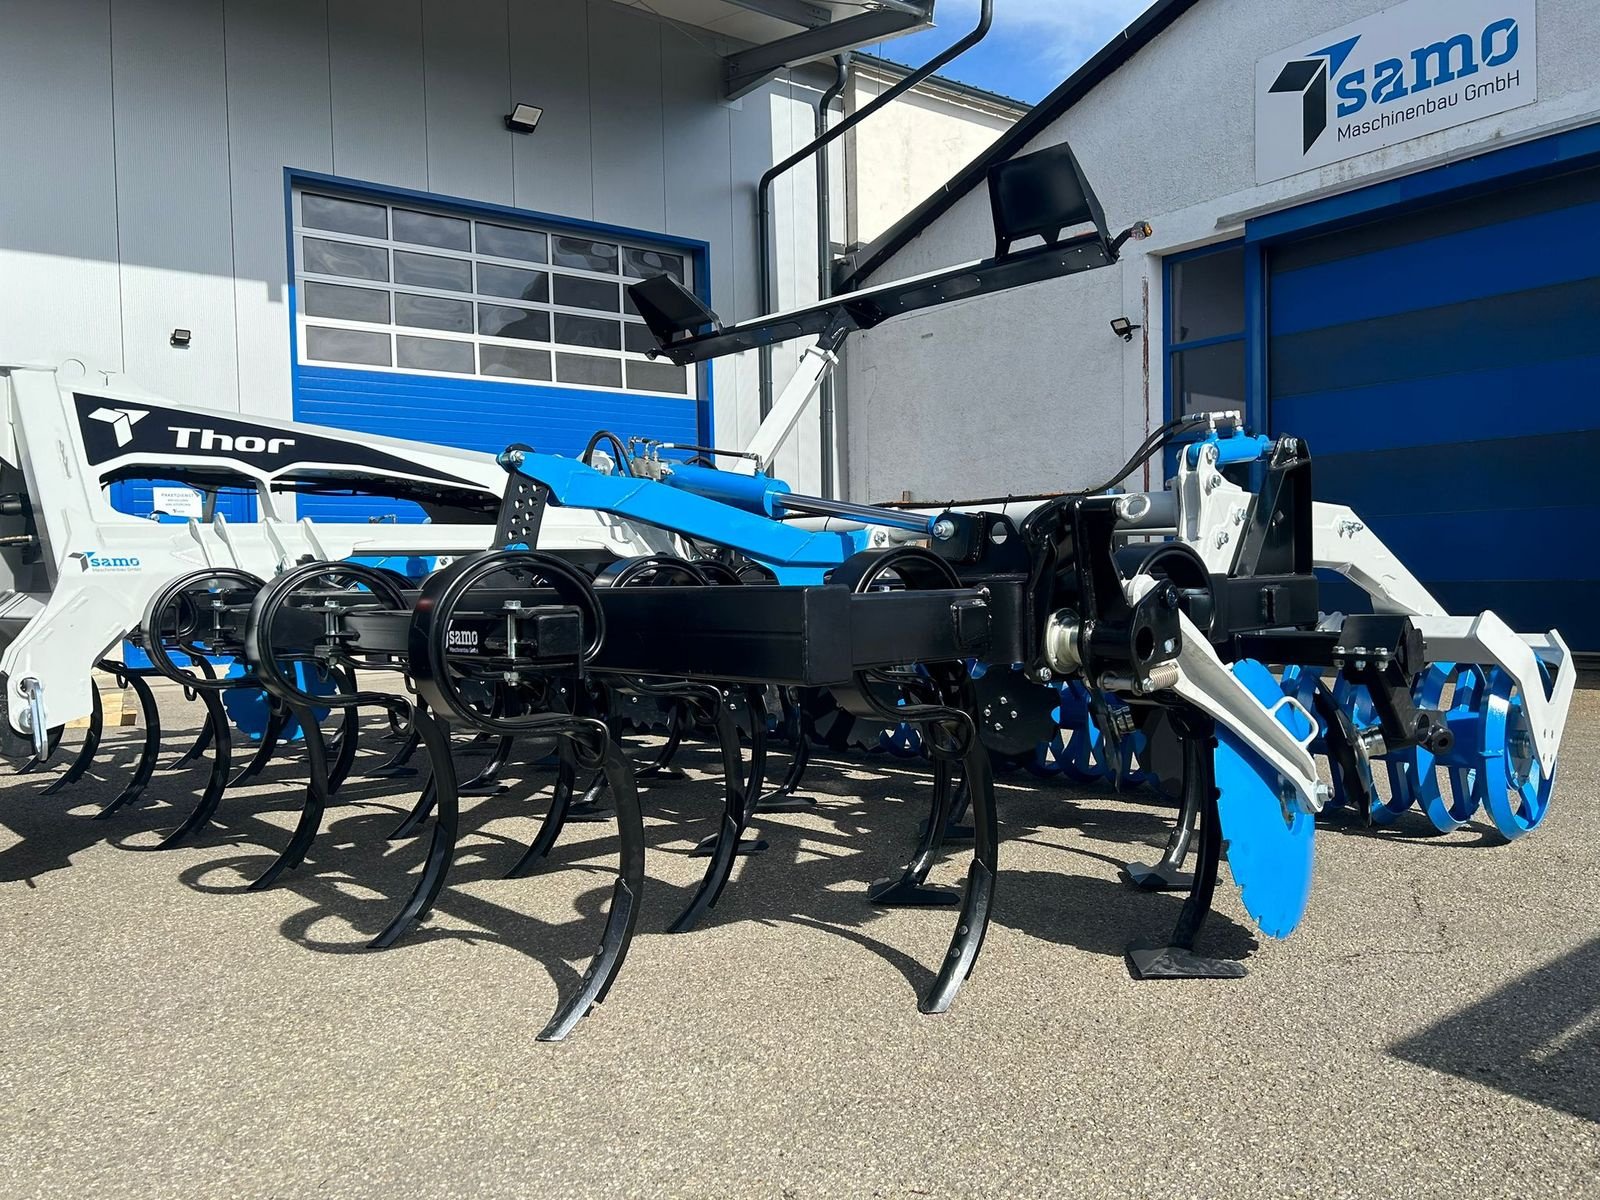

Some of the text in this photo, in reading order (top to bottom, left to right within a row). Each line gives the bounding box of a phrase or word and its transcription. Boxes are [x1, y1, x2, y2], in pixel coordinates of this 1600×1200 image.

[1336, 18, 1519, 118] samo
[1337, 69, 1520, 142] Maschinenbau GmbH
[167, 426, 296, 454] Thor
[90, 557, 140, 567] samo
[449, 630, 478, 645] samo
